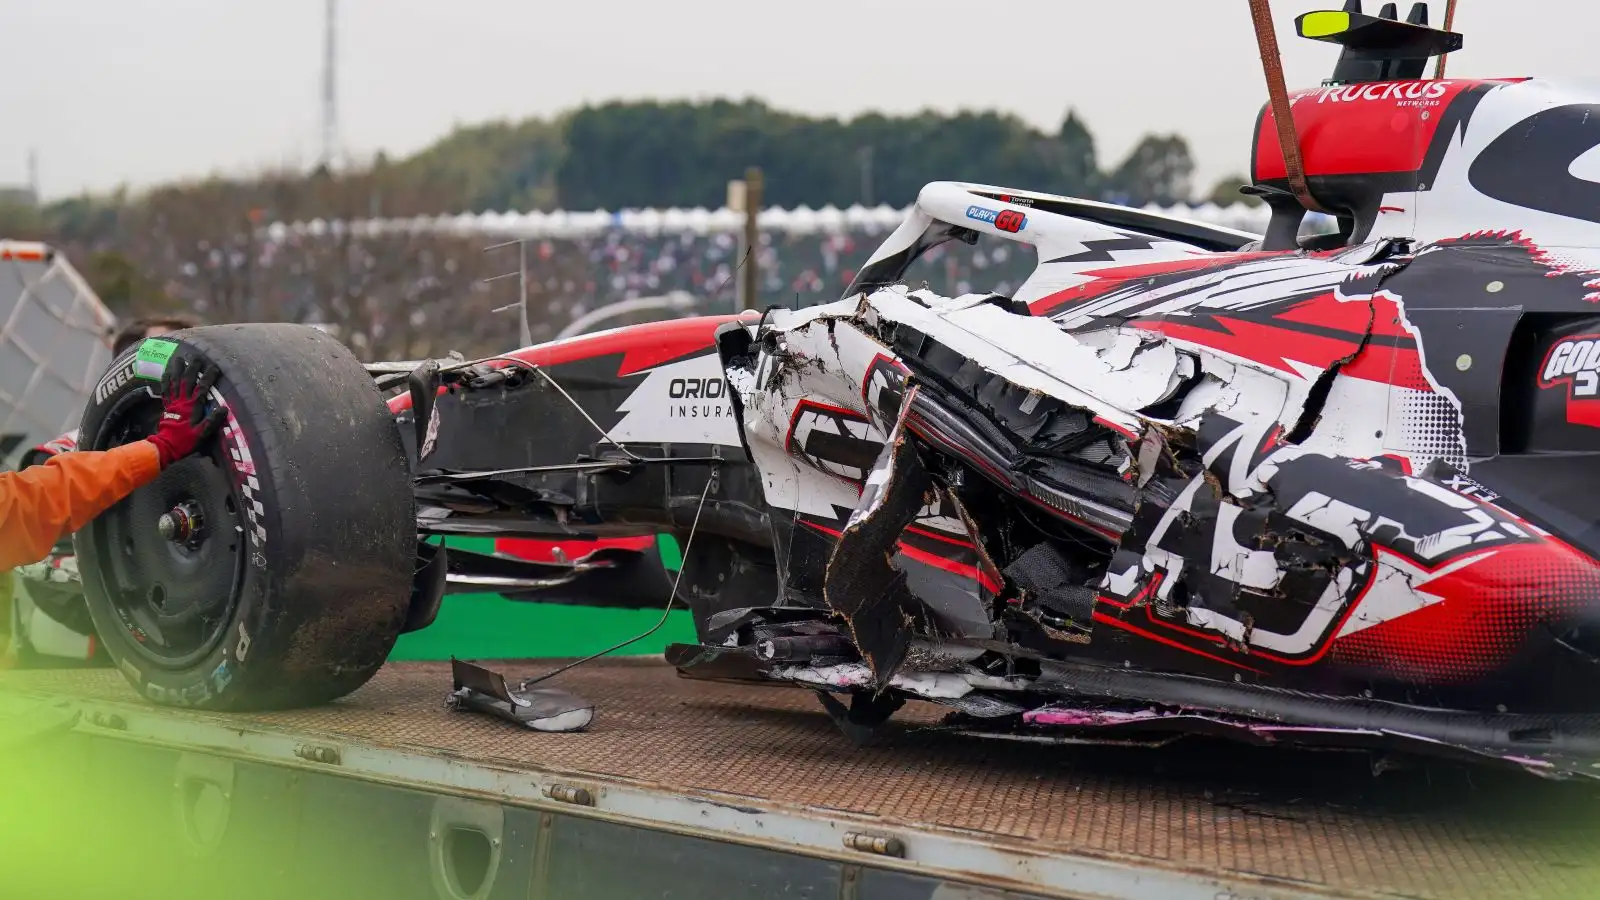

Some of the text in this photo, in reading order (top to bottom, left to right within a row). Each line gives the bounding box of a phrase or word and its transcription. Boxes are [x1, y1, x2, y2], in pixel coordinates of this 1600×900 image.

[1318, 81, 1453, 103] RUCKUS
[995, 210, 1025, 232] GO
[1441, 474, 1496, 502] FIX
